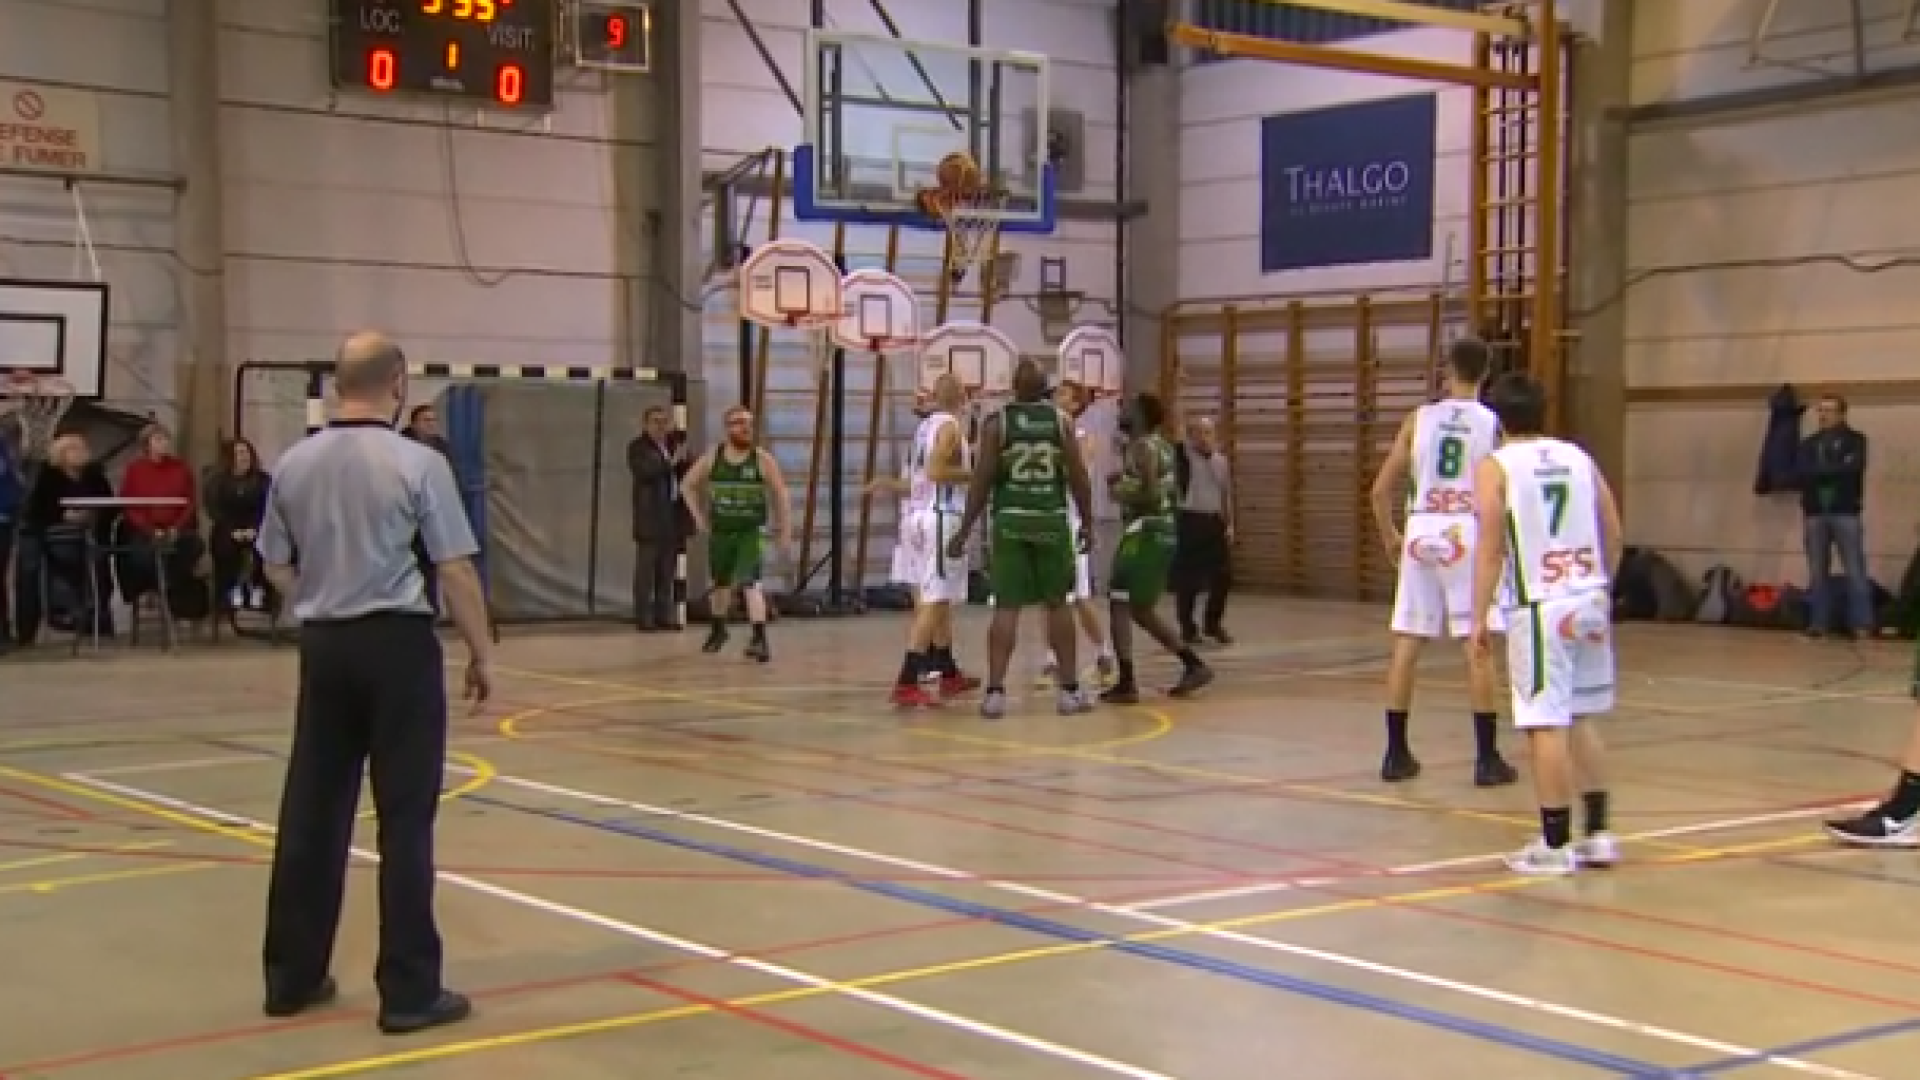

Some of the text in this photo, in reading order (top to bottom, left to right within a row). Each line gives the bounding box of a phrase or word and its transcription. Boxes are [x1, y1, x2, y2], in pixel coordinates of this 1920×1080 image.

[369, 48, 395, 91] 0
[447, 42, 459, 69] 1
[498, 64, 523, 103] 0
[1283, 160, 1409, 203] THALGO
[1009, 439, 1057, 482] 23
[1437, 436, 1465, 479] 8
[1542, 481, 1570, 538] 7
